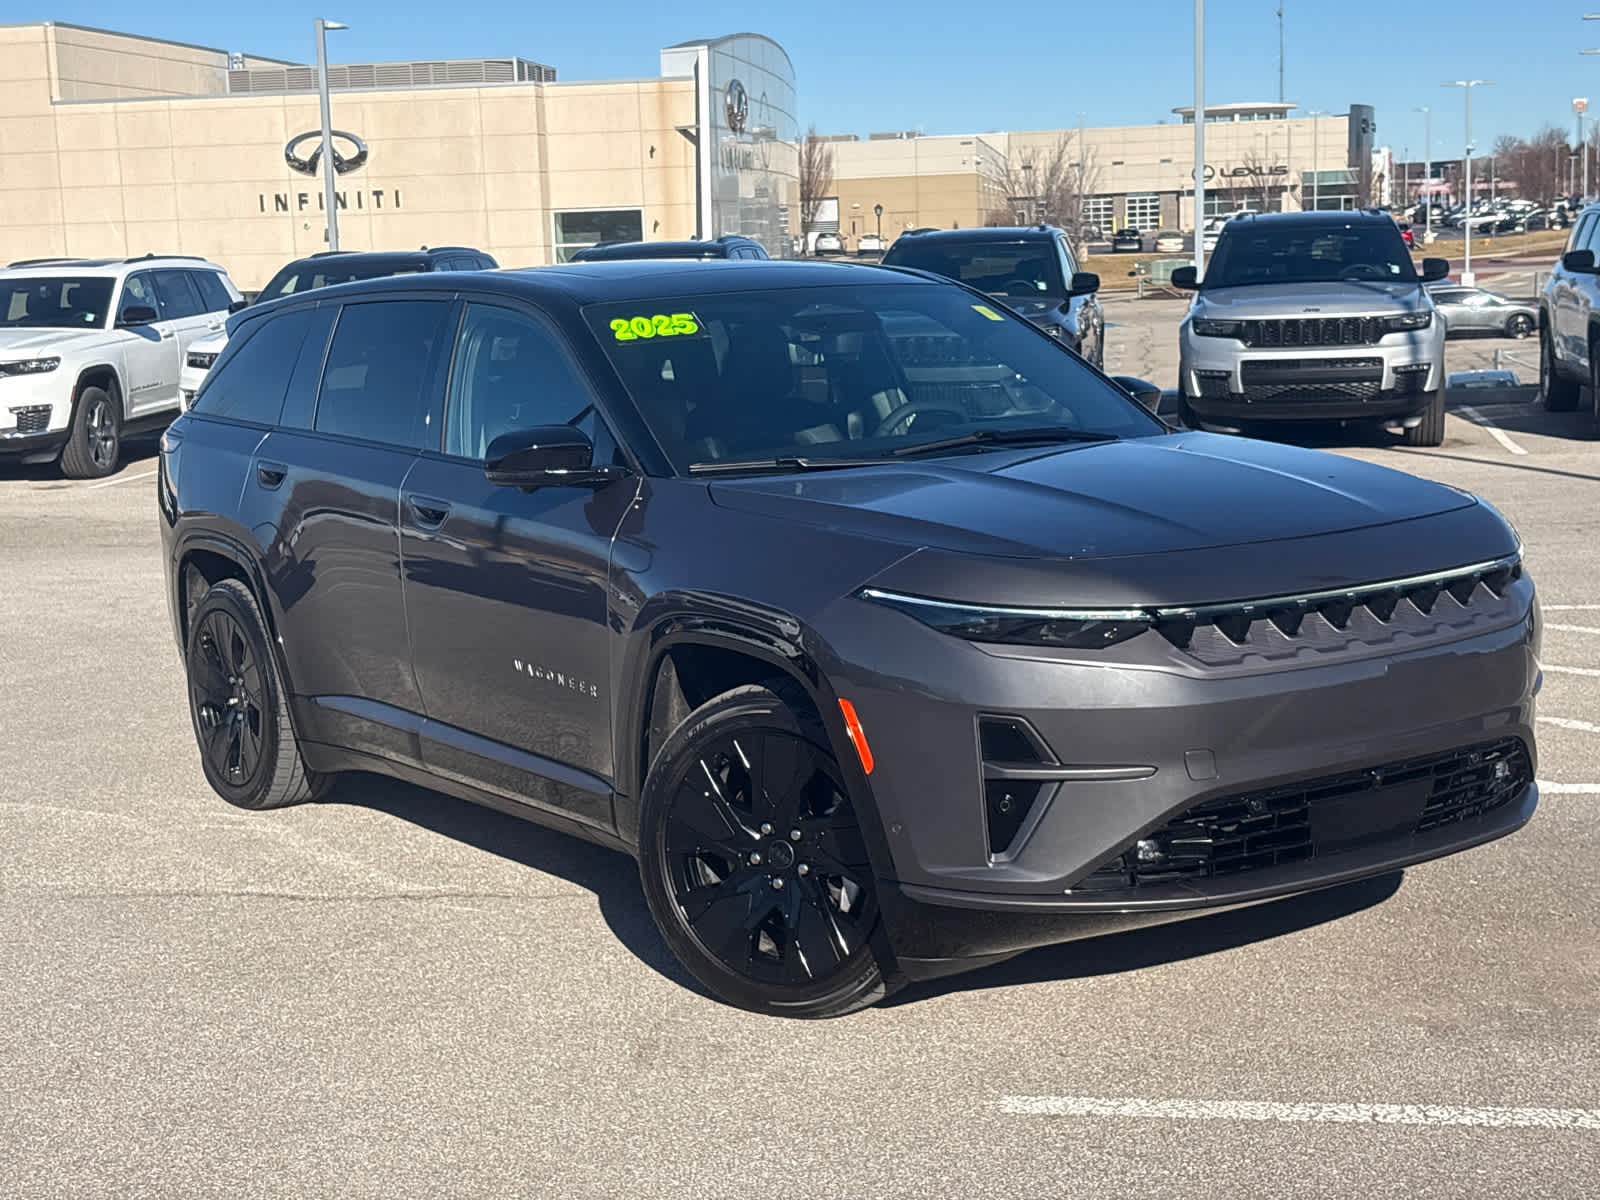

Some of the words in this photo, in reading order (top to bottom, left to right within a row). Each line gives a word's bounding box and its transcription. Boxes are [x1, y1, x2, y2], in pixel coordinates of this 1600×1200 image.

[1220, 165, 1288, 177] LEXUS
[259, 190, 400, 212] INFINITI
[609, 313, 698, 341] 2025
[513, 658, 597, 697] WAGONEER
